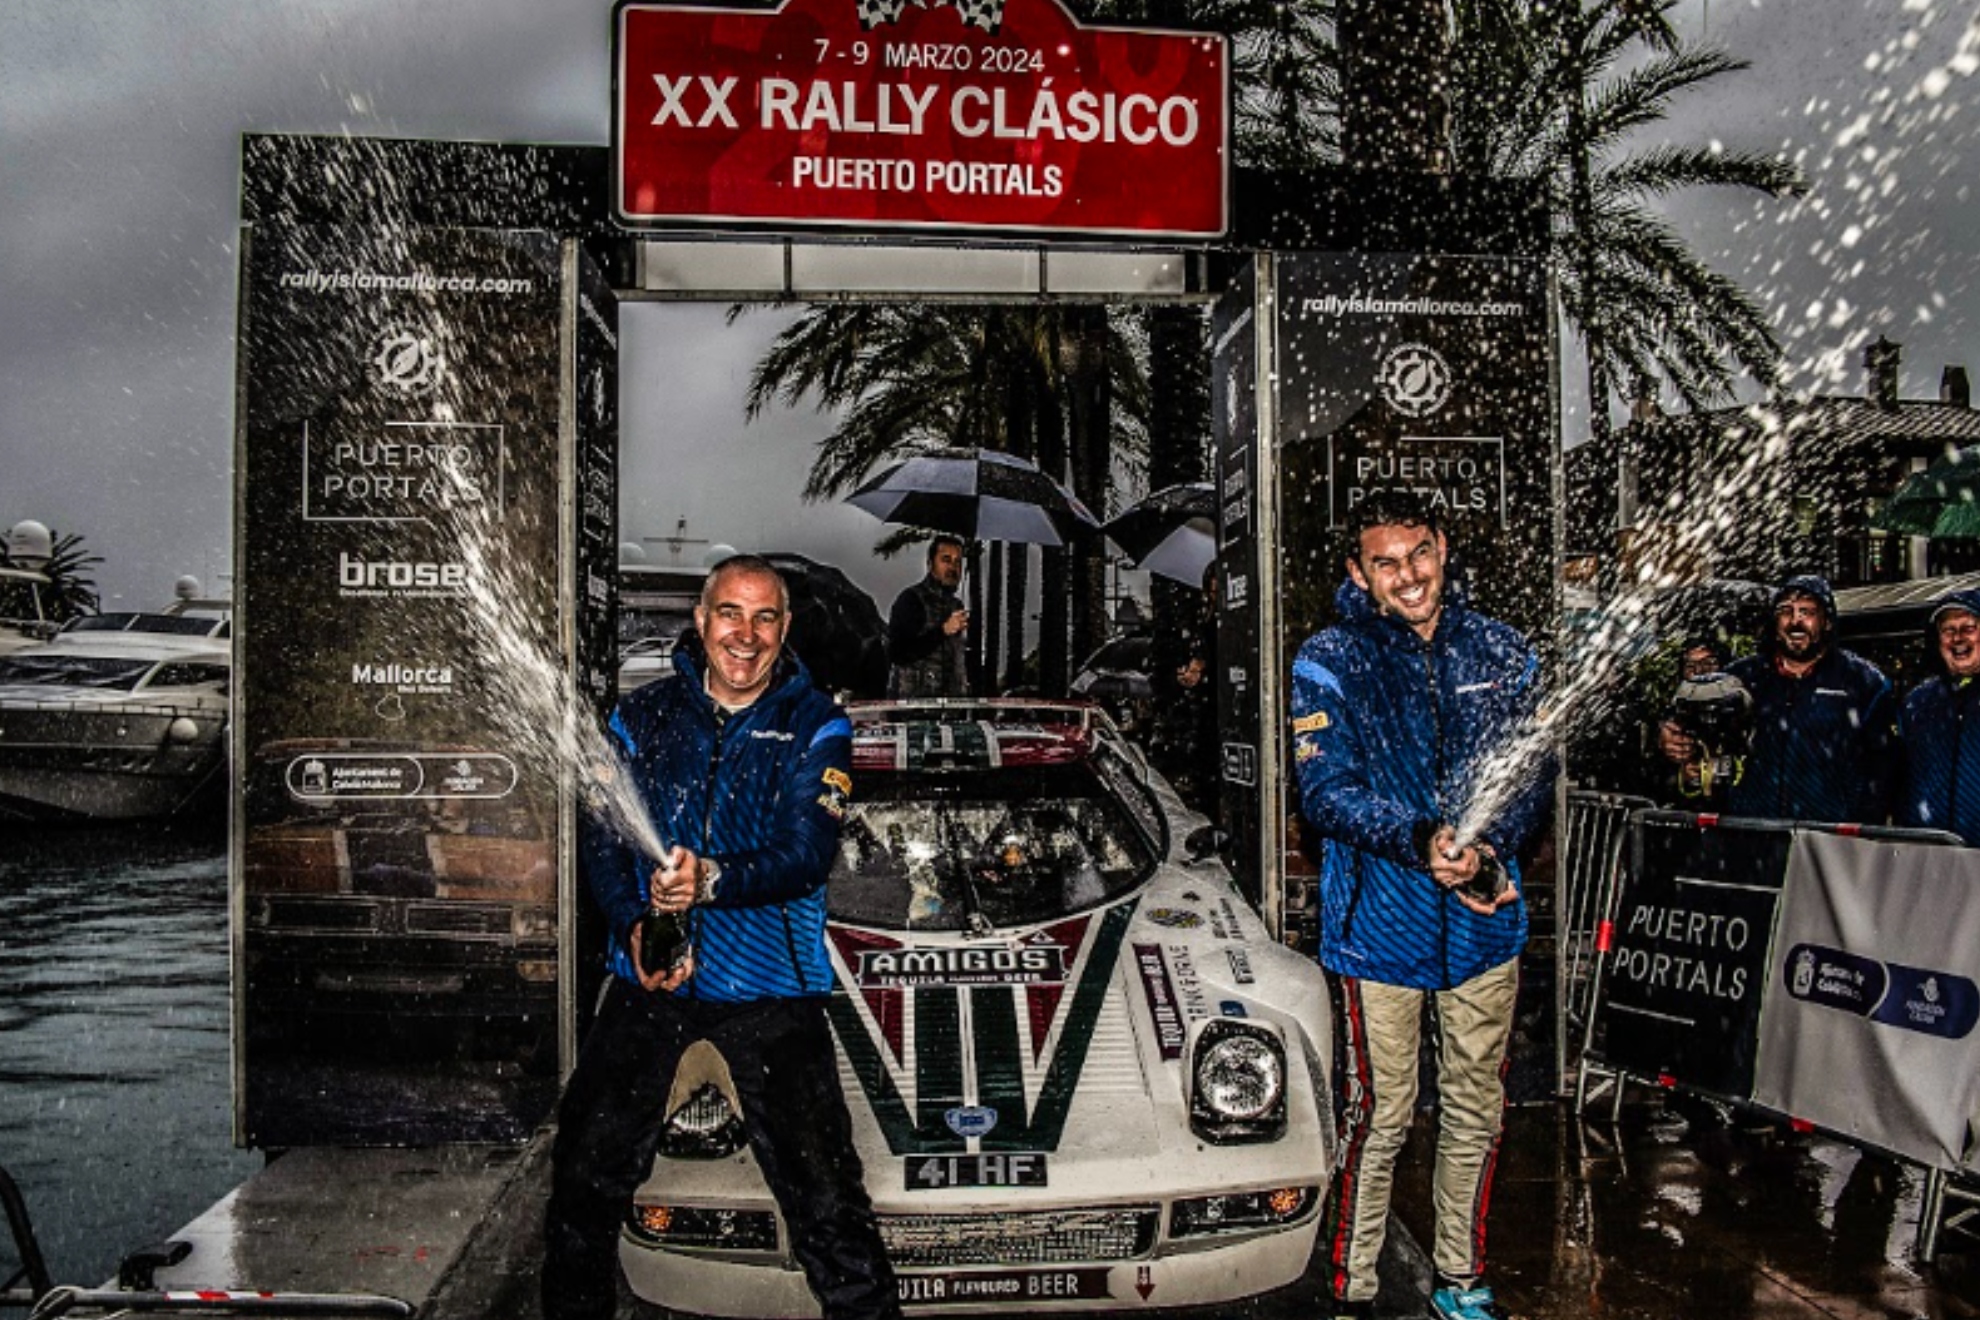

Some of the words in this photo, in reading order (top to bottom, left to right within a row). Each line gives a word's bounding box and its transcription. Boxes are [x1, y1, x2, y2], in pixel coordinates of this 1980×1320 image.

[885, 43, 972, 71] MARZO
[980, 46, 1045, 73] 2024
[651, 74, 739, 128] XX
[760, 78, 937, 135] RALLY
[950, 77, 1198, 145] CLÁSICO
[793, 156, 915, 191] PUERTO
[926, 161, 1063, 197] PORTALS
[280, 269, 532, 293] rallyislamallorca.com
[1302, 295, 1524, 318] rallyislamallorca.com
[334, 443, 472, 467] PUERTO
[1357, 457, 1477, 479] PUERTO
[1347, 486, 1487, 510] PTALS
[339, 551, 465, 587] brose
[352, 662, 452, 684] Mallorca
[1628, 904, 1749, 952] PUERTO
[871, 950, 1050, 973] AMIGOS
[1611, 946, 1748, 1001] PORTALS
[917, 1156, 958, 1187] 41
[978, 1155, 1036, 1185] HF
[1027, 1274, 1079, 1296] BEER
